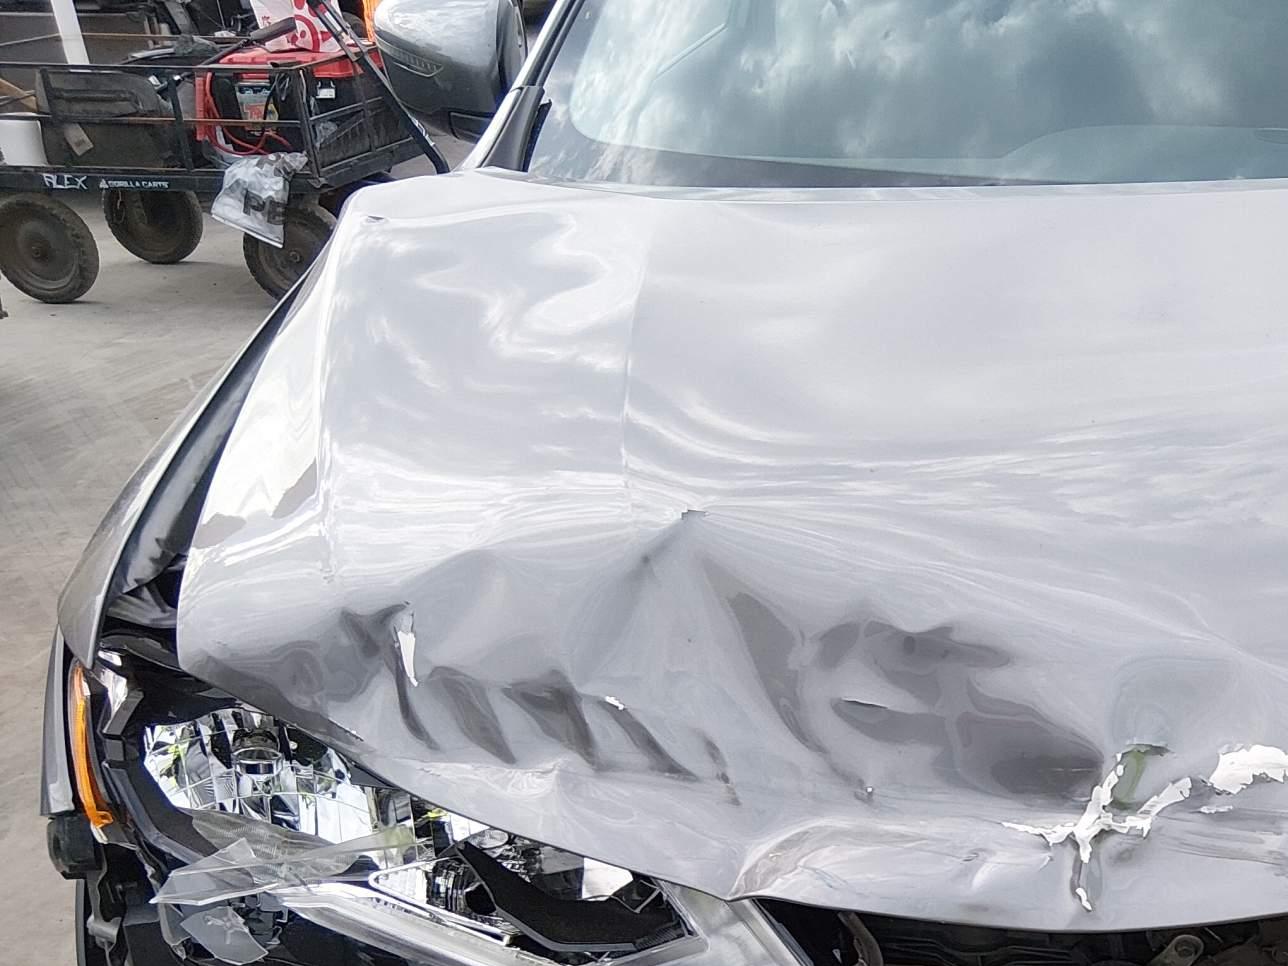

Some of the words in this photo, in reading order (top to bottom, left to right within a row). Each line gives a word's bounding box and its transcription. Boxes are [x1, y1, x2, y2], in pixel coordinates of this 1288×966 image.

[43, 173, 87, 189] ALEX
[109, 180, 141, 188] GORILLA
[142, 181, 169, 189] CARTS
